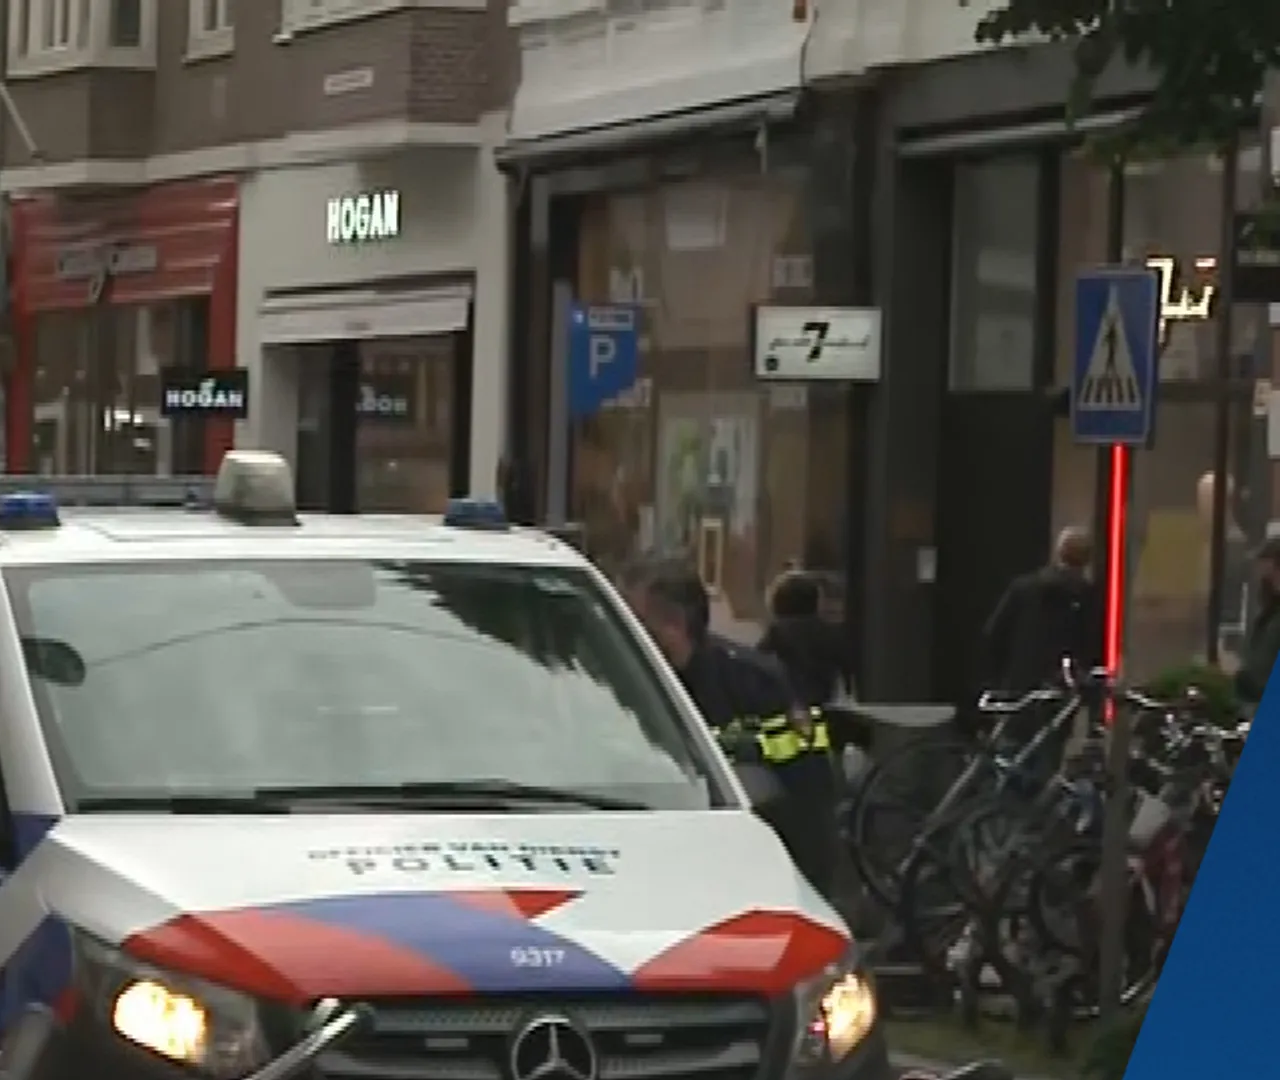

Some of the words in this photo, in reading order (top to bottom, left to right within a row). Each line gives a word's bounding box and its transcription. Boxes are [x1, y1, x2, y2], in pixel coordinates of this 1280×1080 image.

[326, 191, 400, 243] HOGAN
[589, 335, 616, 379] P
[165, 390, 244, 408] HOGAN
[346, 854, 617, 875] POLITIE
